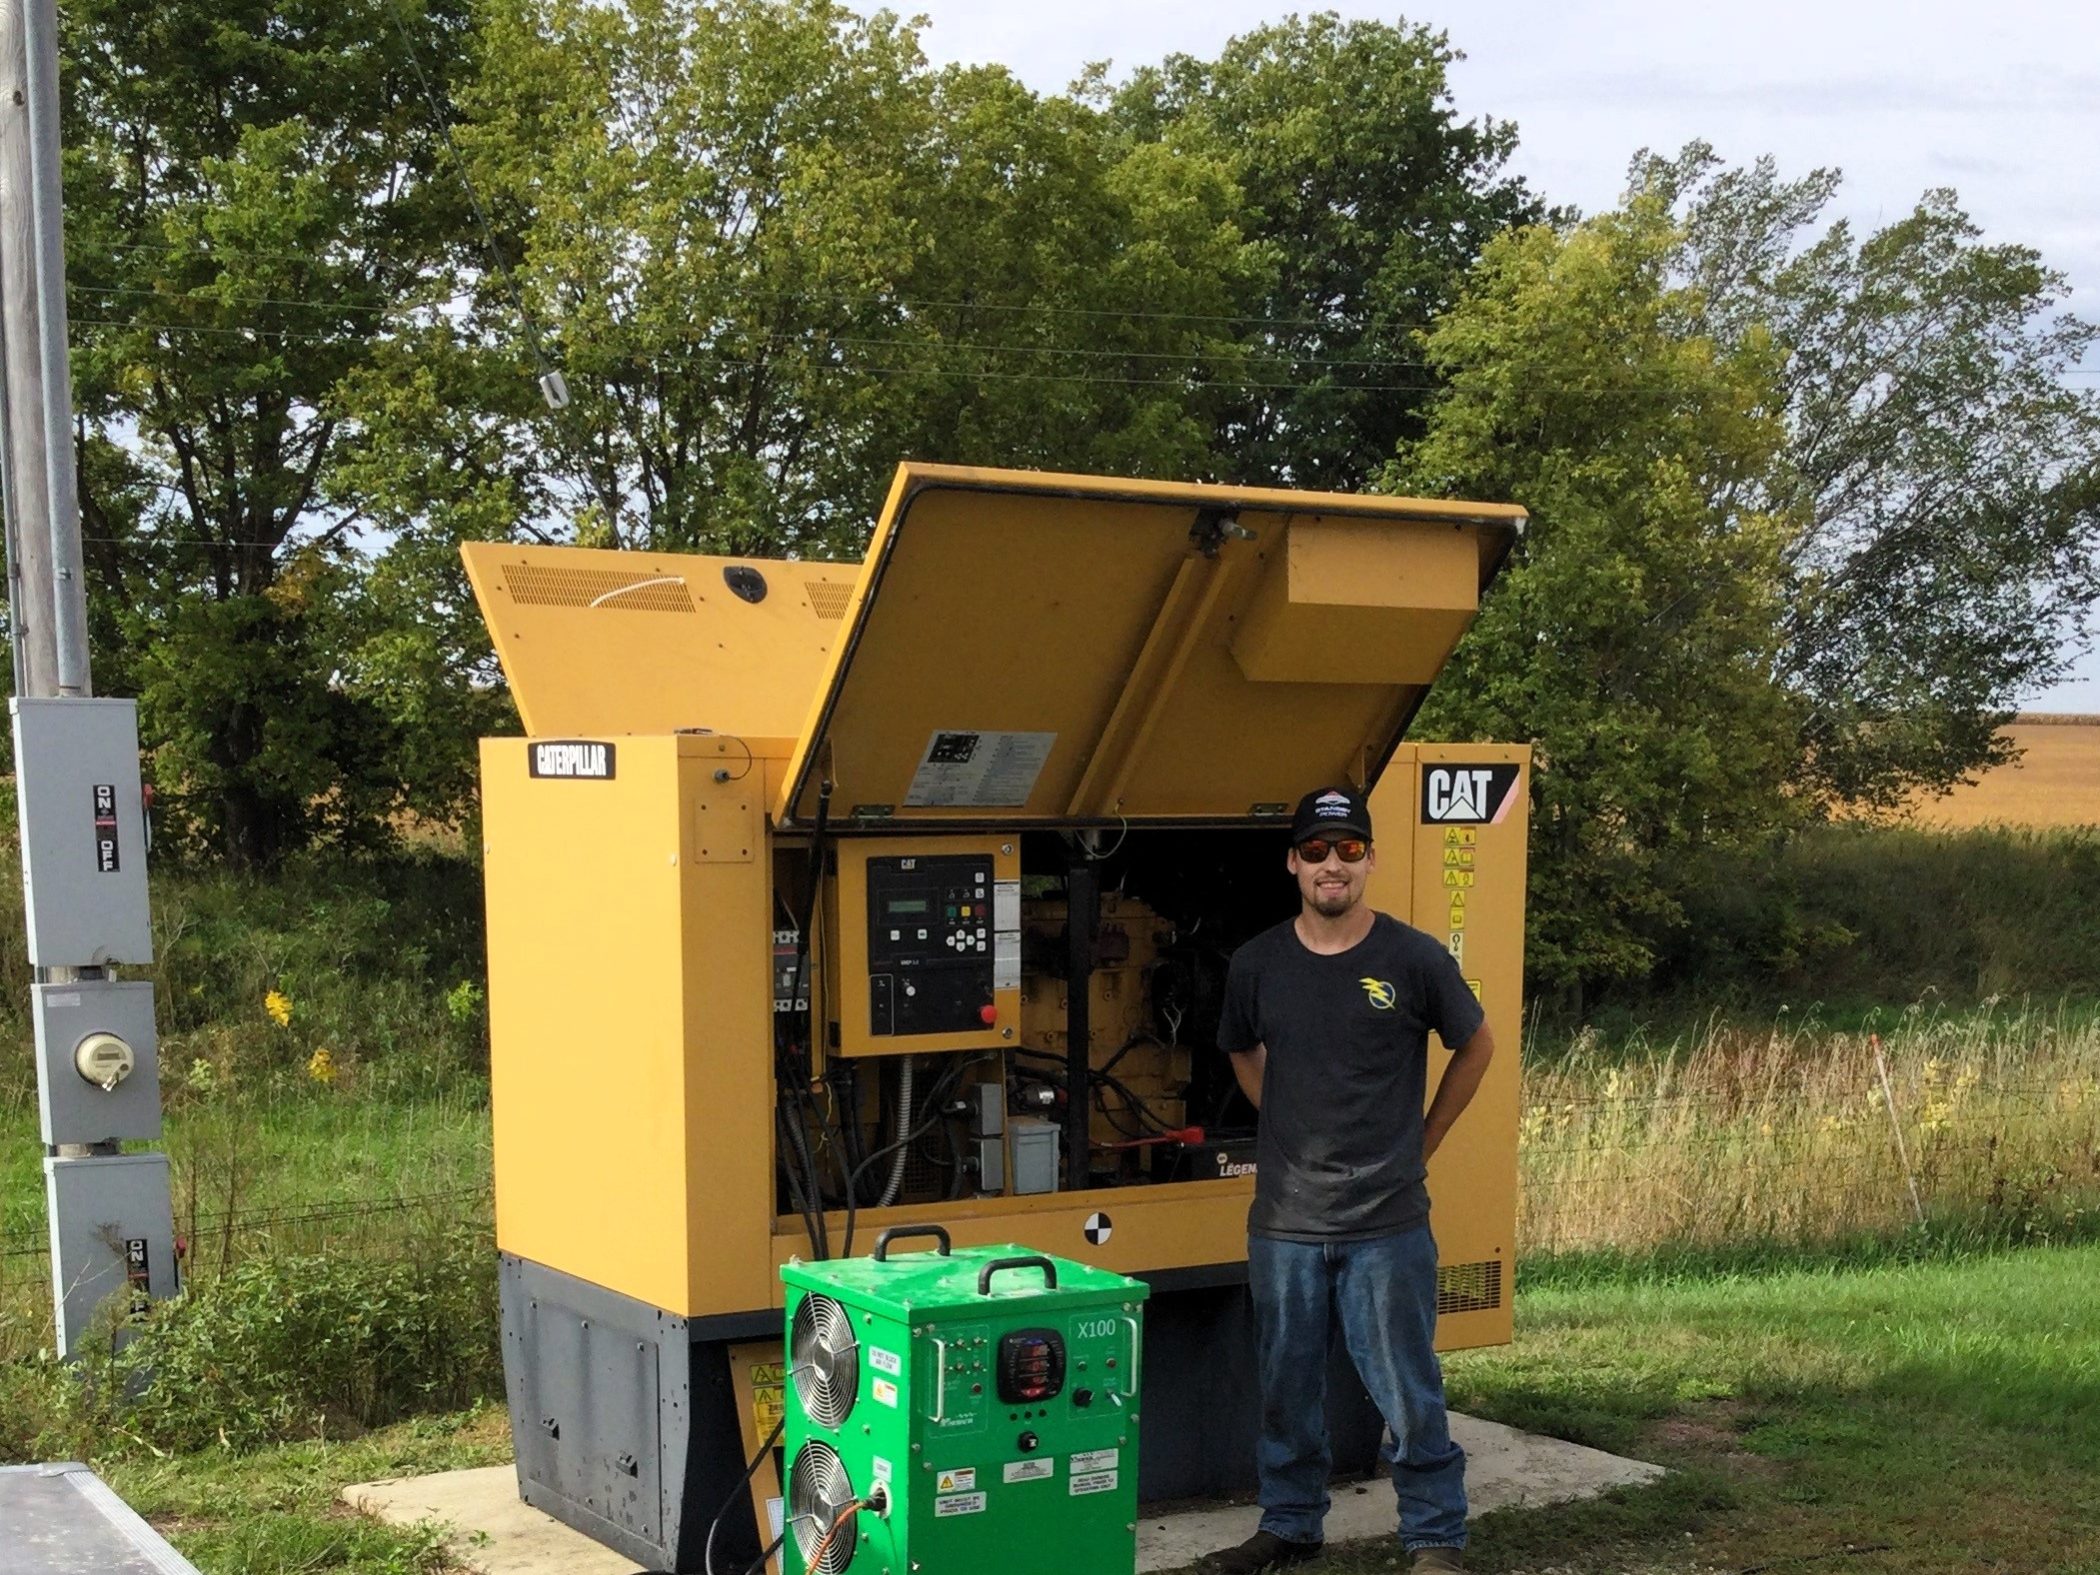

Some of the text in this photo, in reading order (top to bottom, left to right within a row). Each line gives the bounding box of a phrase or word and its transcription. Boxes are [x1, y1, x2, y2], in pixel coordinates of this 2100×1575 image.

[537, 744, 606, 776] CATERPILLAR
[97, 785, 112, 809] ON
[1428, 769, 1493, 820] CAT
[101, 840, 114, 872] OFF
[901, 859, 917, 870] CAT
[130, 1240, 144, 1262] ON
[1077, 1319, 1116, 1339] X100
